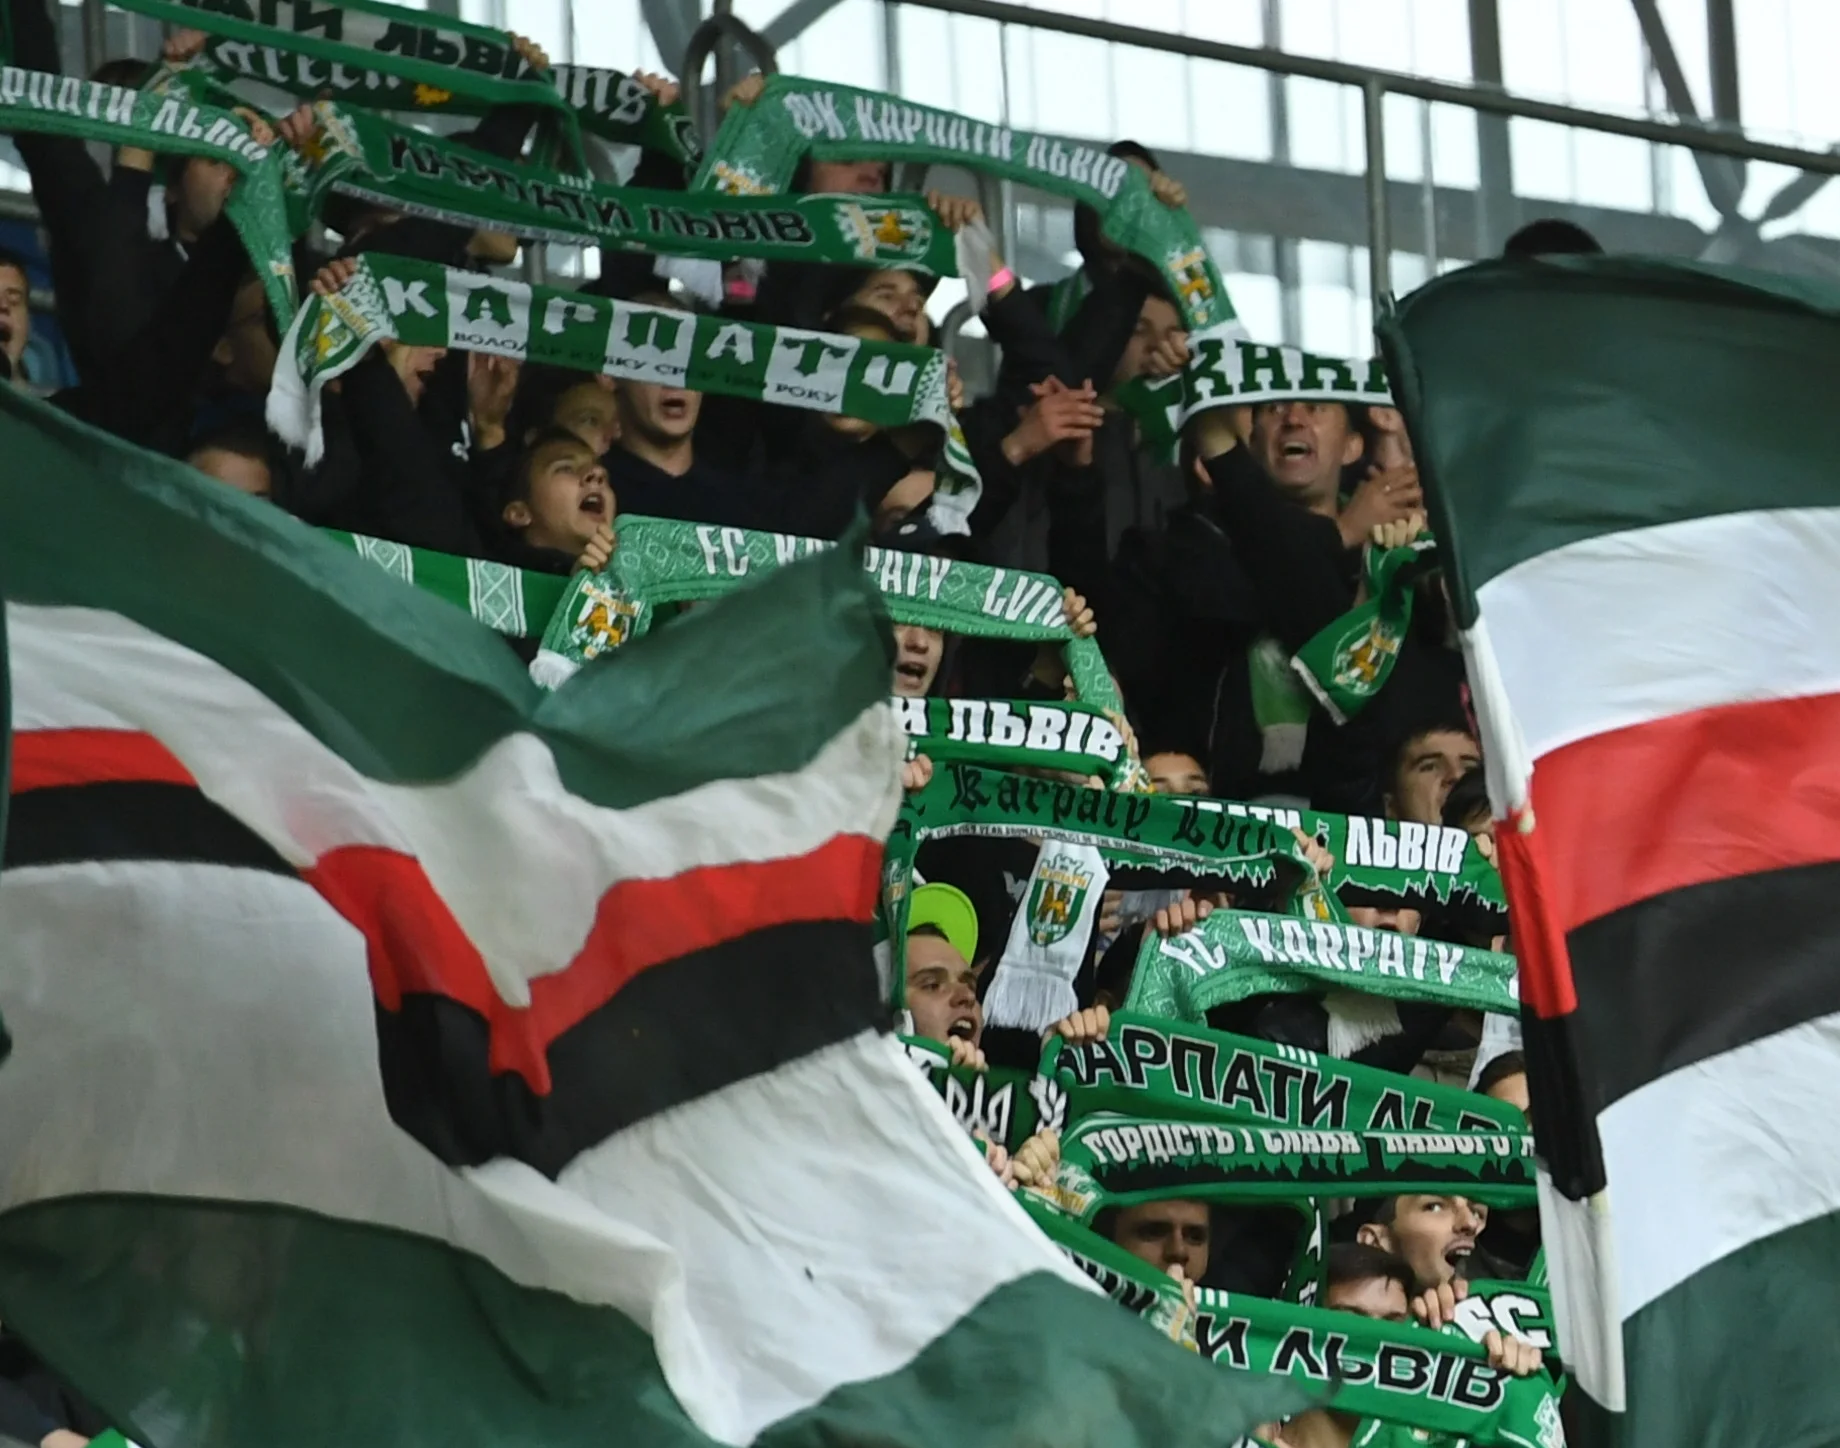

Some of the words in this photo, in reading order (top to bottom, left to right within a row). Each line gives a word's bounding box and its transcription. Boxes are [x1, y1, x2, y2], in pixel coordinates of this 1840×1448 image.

[1, 66, 138, 126] РПАТИ
[696, 526, 749, 576] FC
[948, 698, 1123, 763] ЛЬВІВ
[1344, 815, 1470, 875] ЛЬВІВ
[1238, 916, 1465, 986] KARPATY
[1056, 1024, 1352, 1132] АРПАТИ
[1269, 1325, 1505, 1412] ЛЬВІВ
